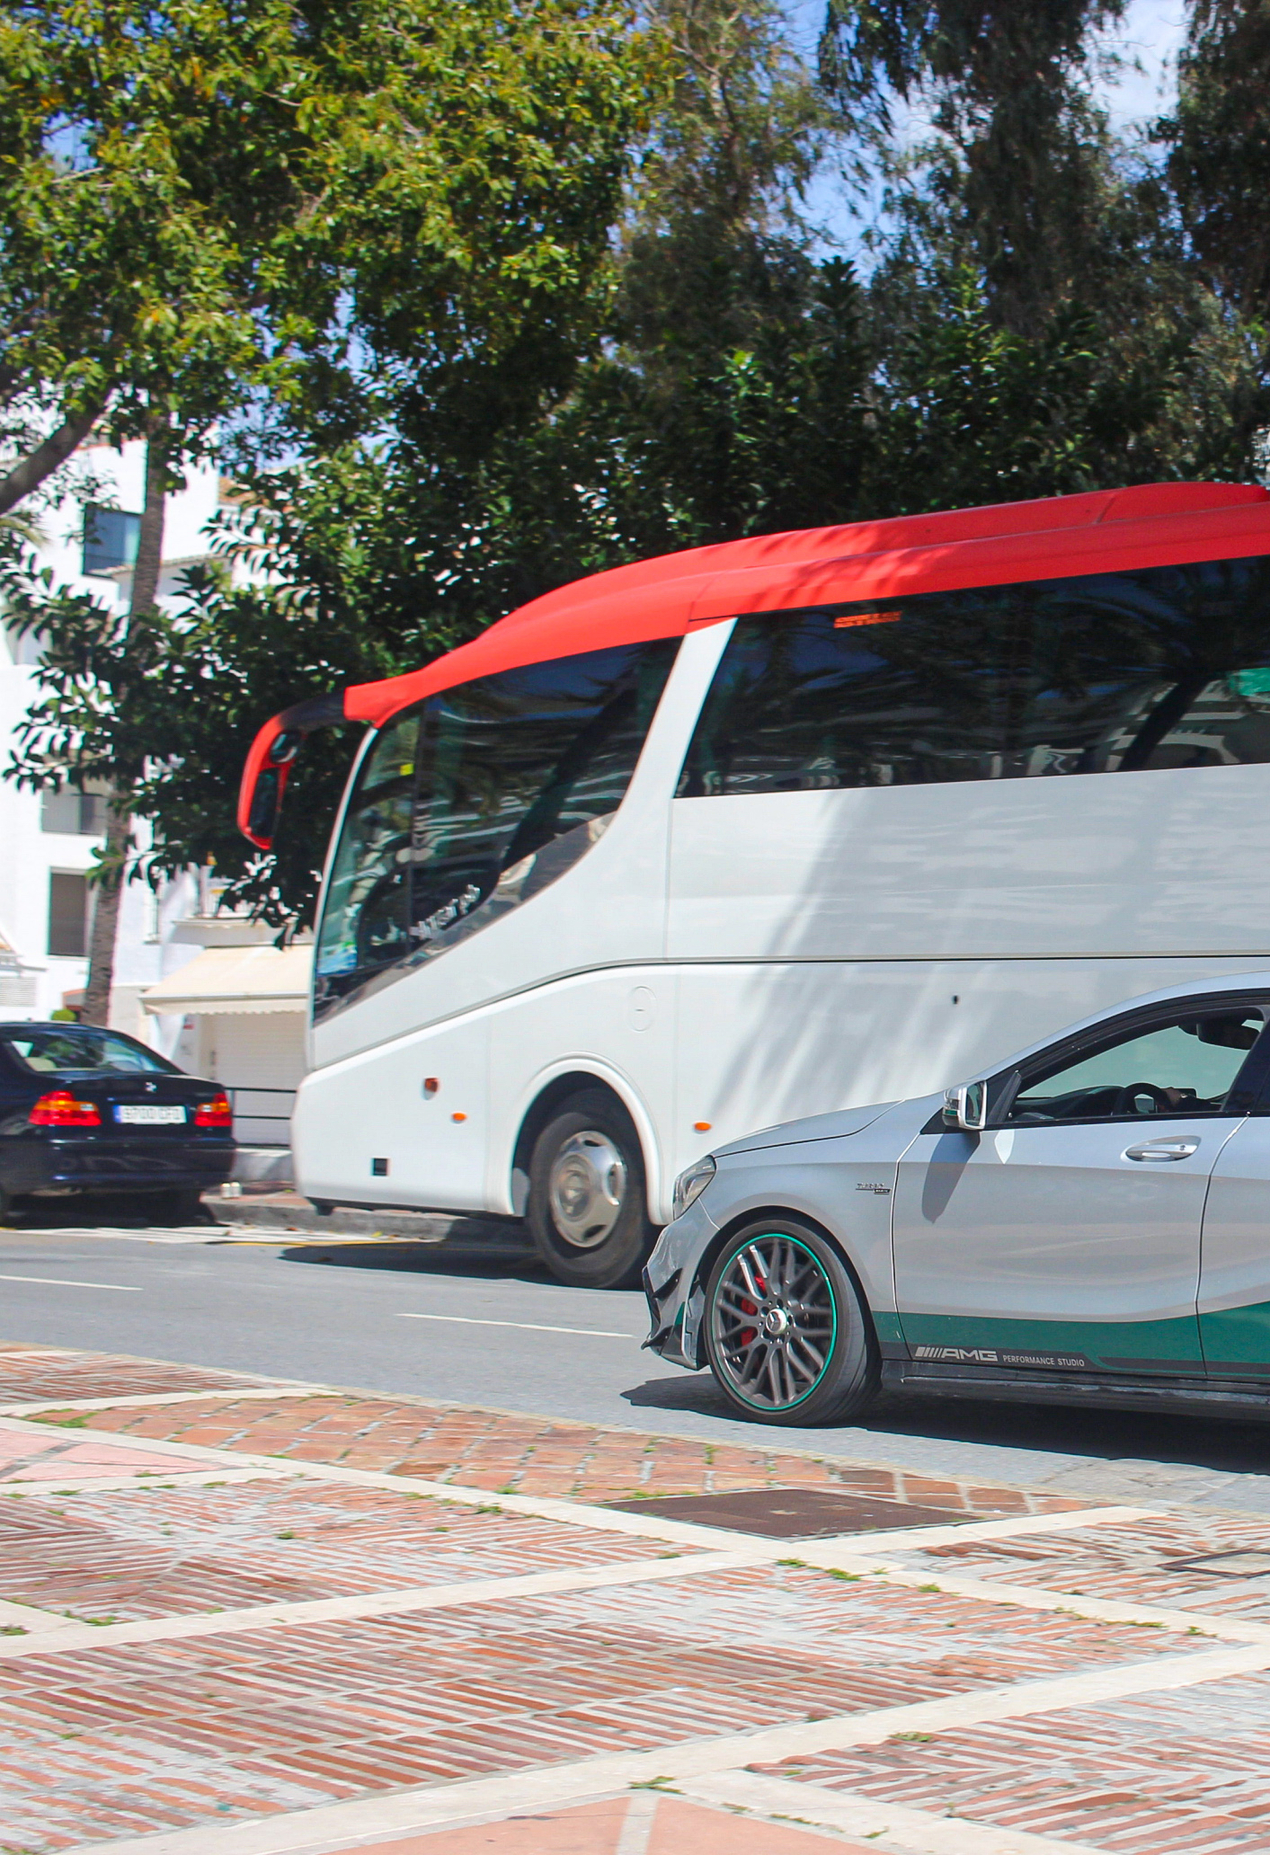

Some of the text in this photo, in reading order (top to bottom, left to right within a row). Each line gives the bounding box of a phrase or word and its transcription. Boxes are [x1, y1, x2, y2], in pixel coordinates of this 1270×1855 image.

[941, 1348, 1085, 1367] AMG PERFORMANCE STUDIO
